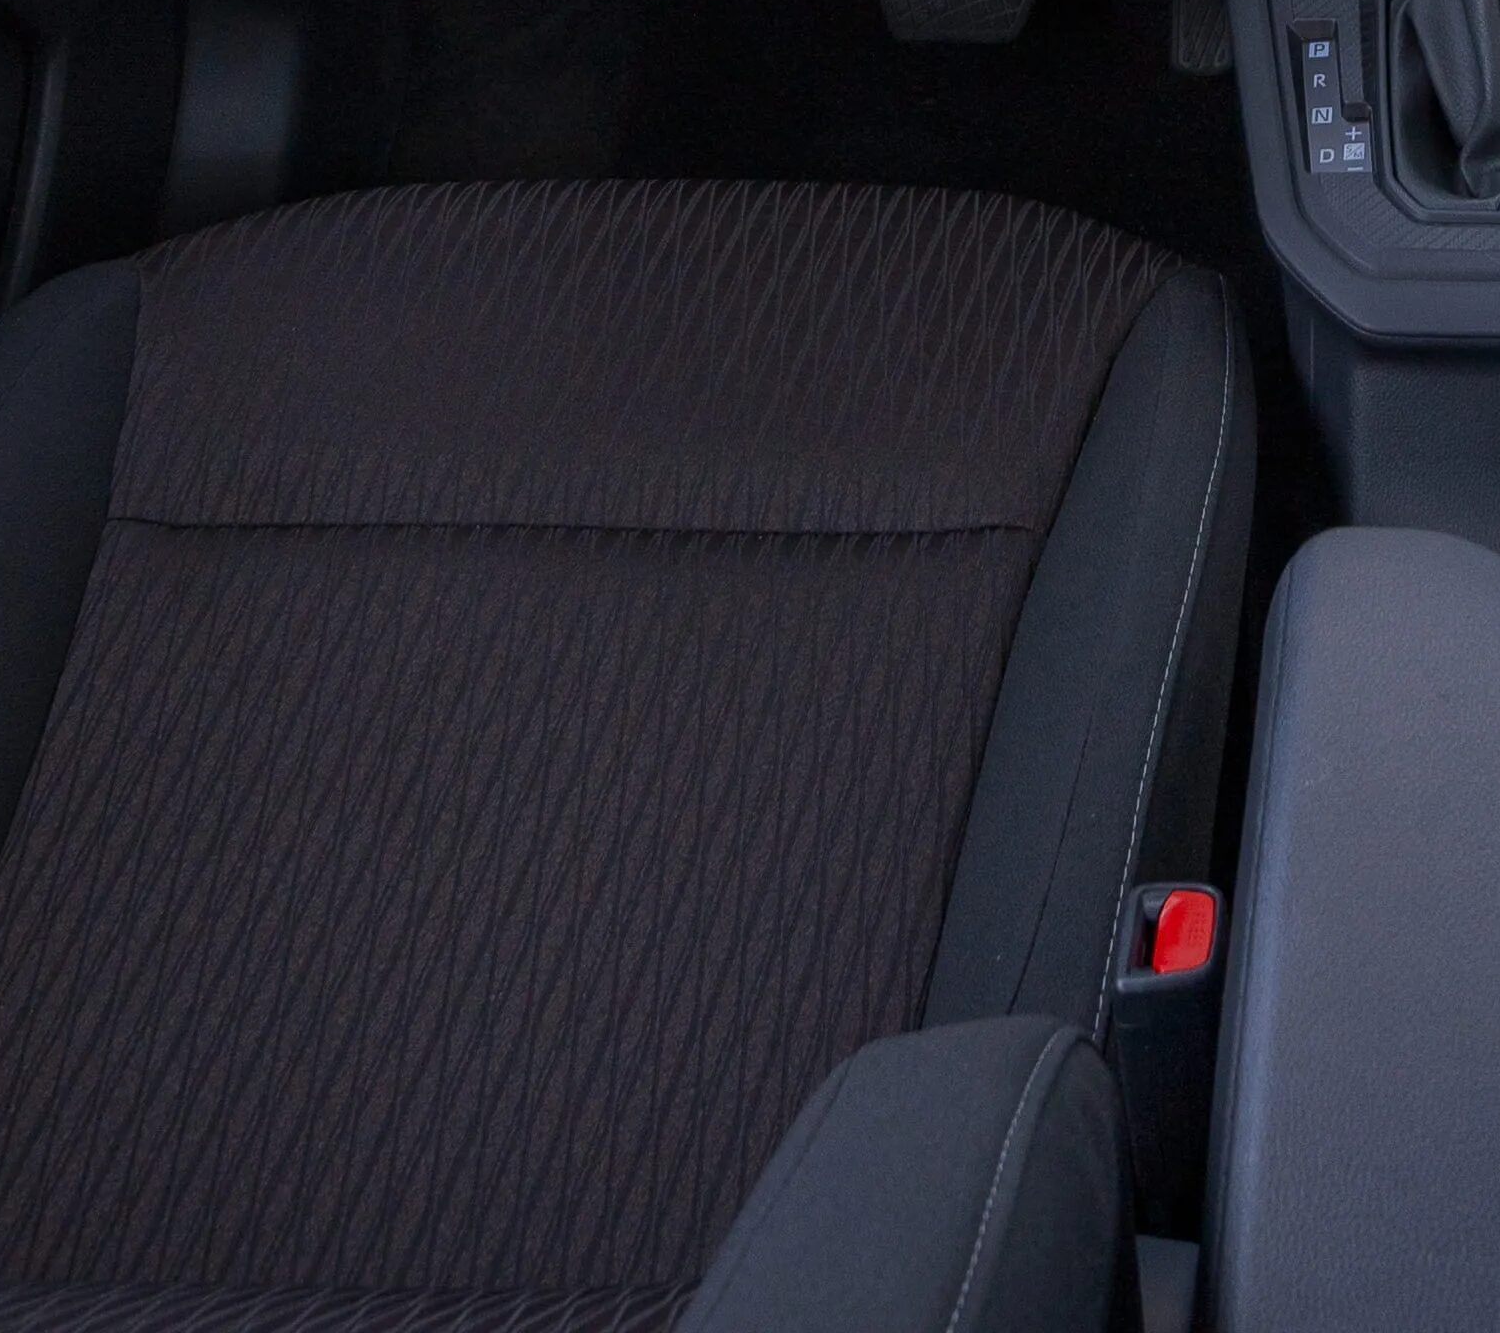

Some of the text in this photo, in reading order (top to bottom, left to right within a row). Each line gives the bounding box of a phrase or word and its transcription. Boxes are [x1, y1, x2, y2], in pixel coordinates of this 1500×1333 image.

[1314, 43, 1325, 56] P
[1313, 74, 1326, 88] R
[1315, 108, 1329, 121] N
[1319, 148, 1335, 163] D
